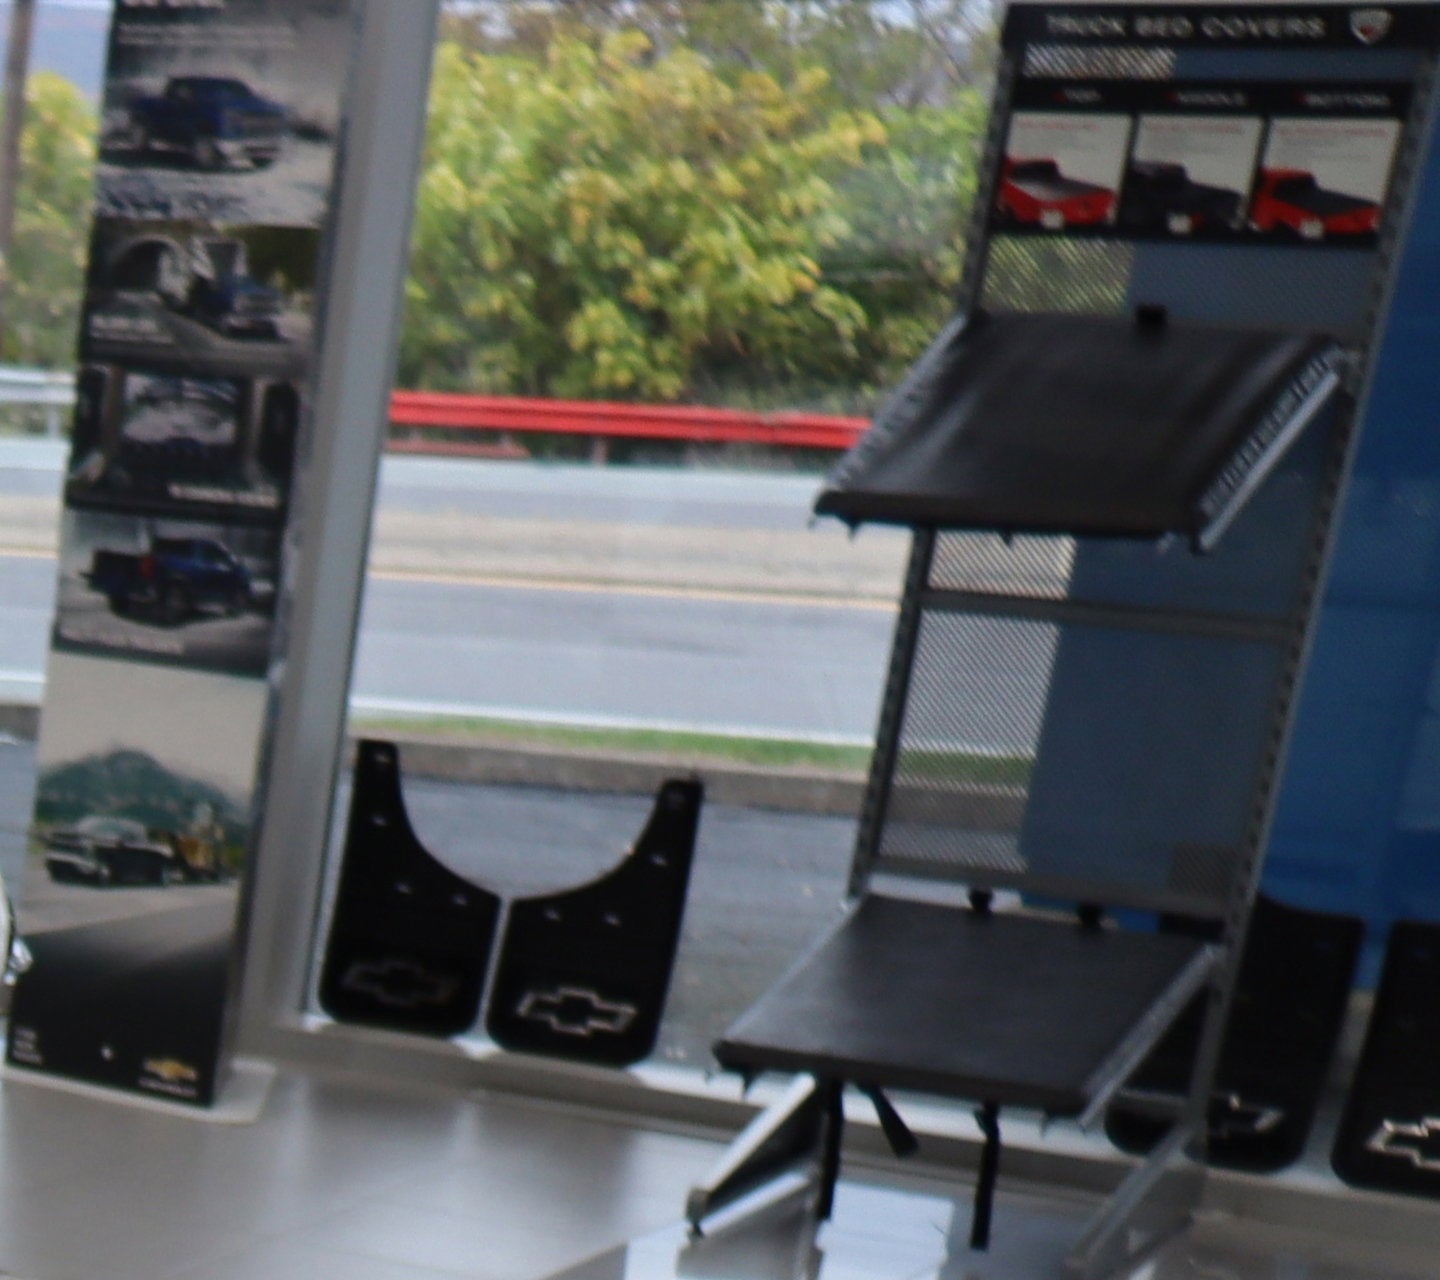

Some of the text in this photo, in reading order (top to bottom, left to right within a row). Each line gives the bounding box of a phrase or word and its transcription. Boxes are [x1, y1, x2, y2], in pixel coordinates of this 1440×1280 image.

[1046, 13, 1327, 39] TRUCK BED COVERS
